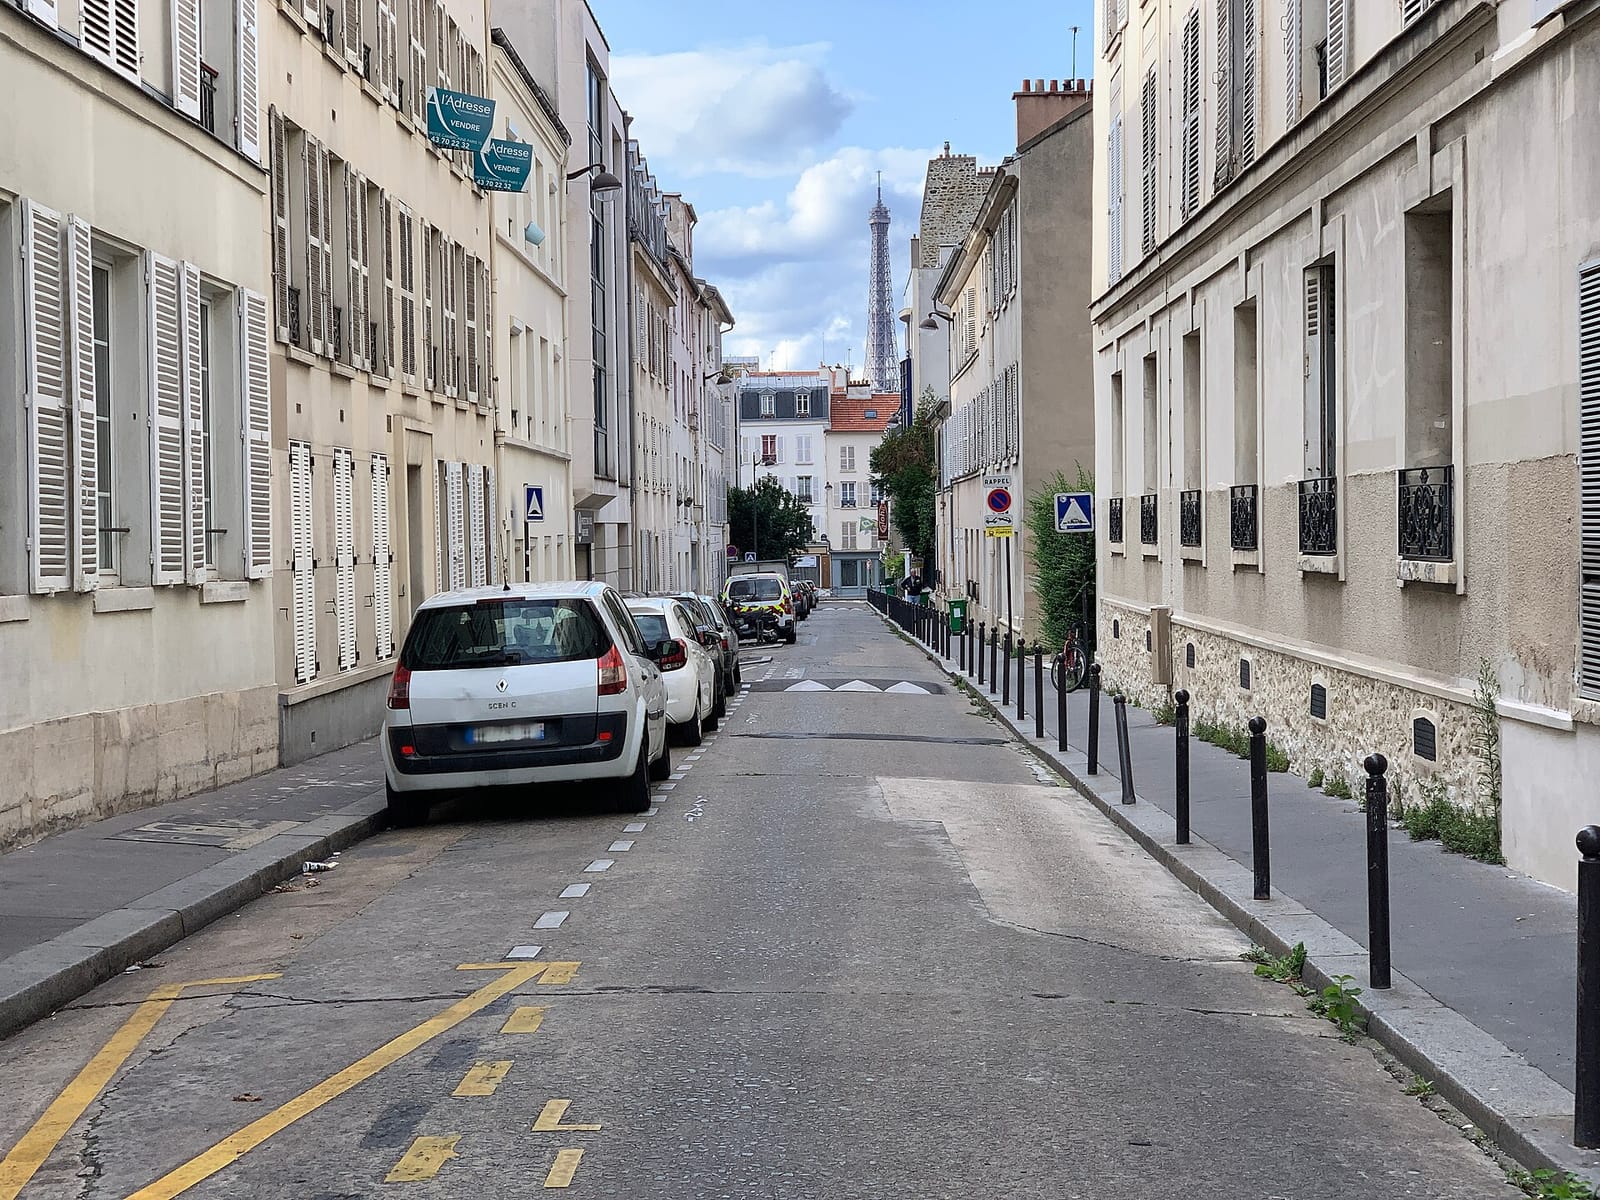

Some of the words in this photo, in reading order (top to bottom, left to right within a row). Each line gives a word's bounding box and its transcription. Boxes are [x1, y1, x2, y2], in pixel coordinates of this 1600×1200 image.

[441, 94, 491, 115] l'Adresse
[450, 119, 480, 132] VENDRE
[430, 135, 440, 143] 43
[441, 137, 450, 145] 70
[451, 139, 460, 147] 22
[461, 141, 470, 149] 32
[489, 142, 529, 158] Adresse
[493, 163, 520, 174] VENDRE
[476, 178, 484, 186] 43
[503, 182, 512, 190] 32
